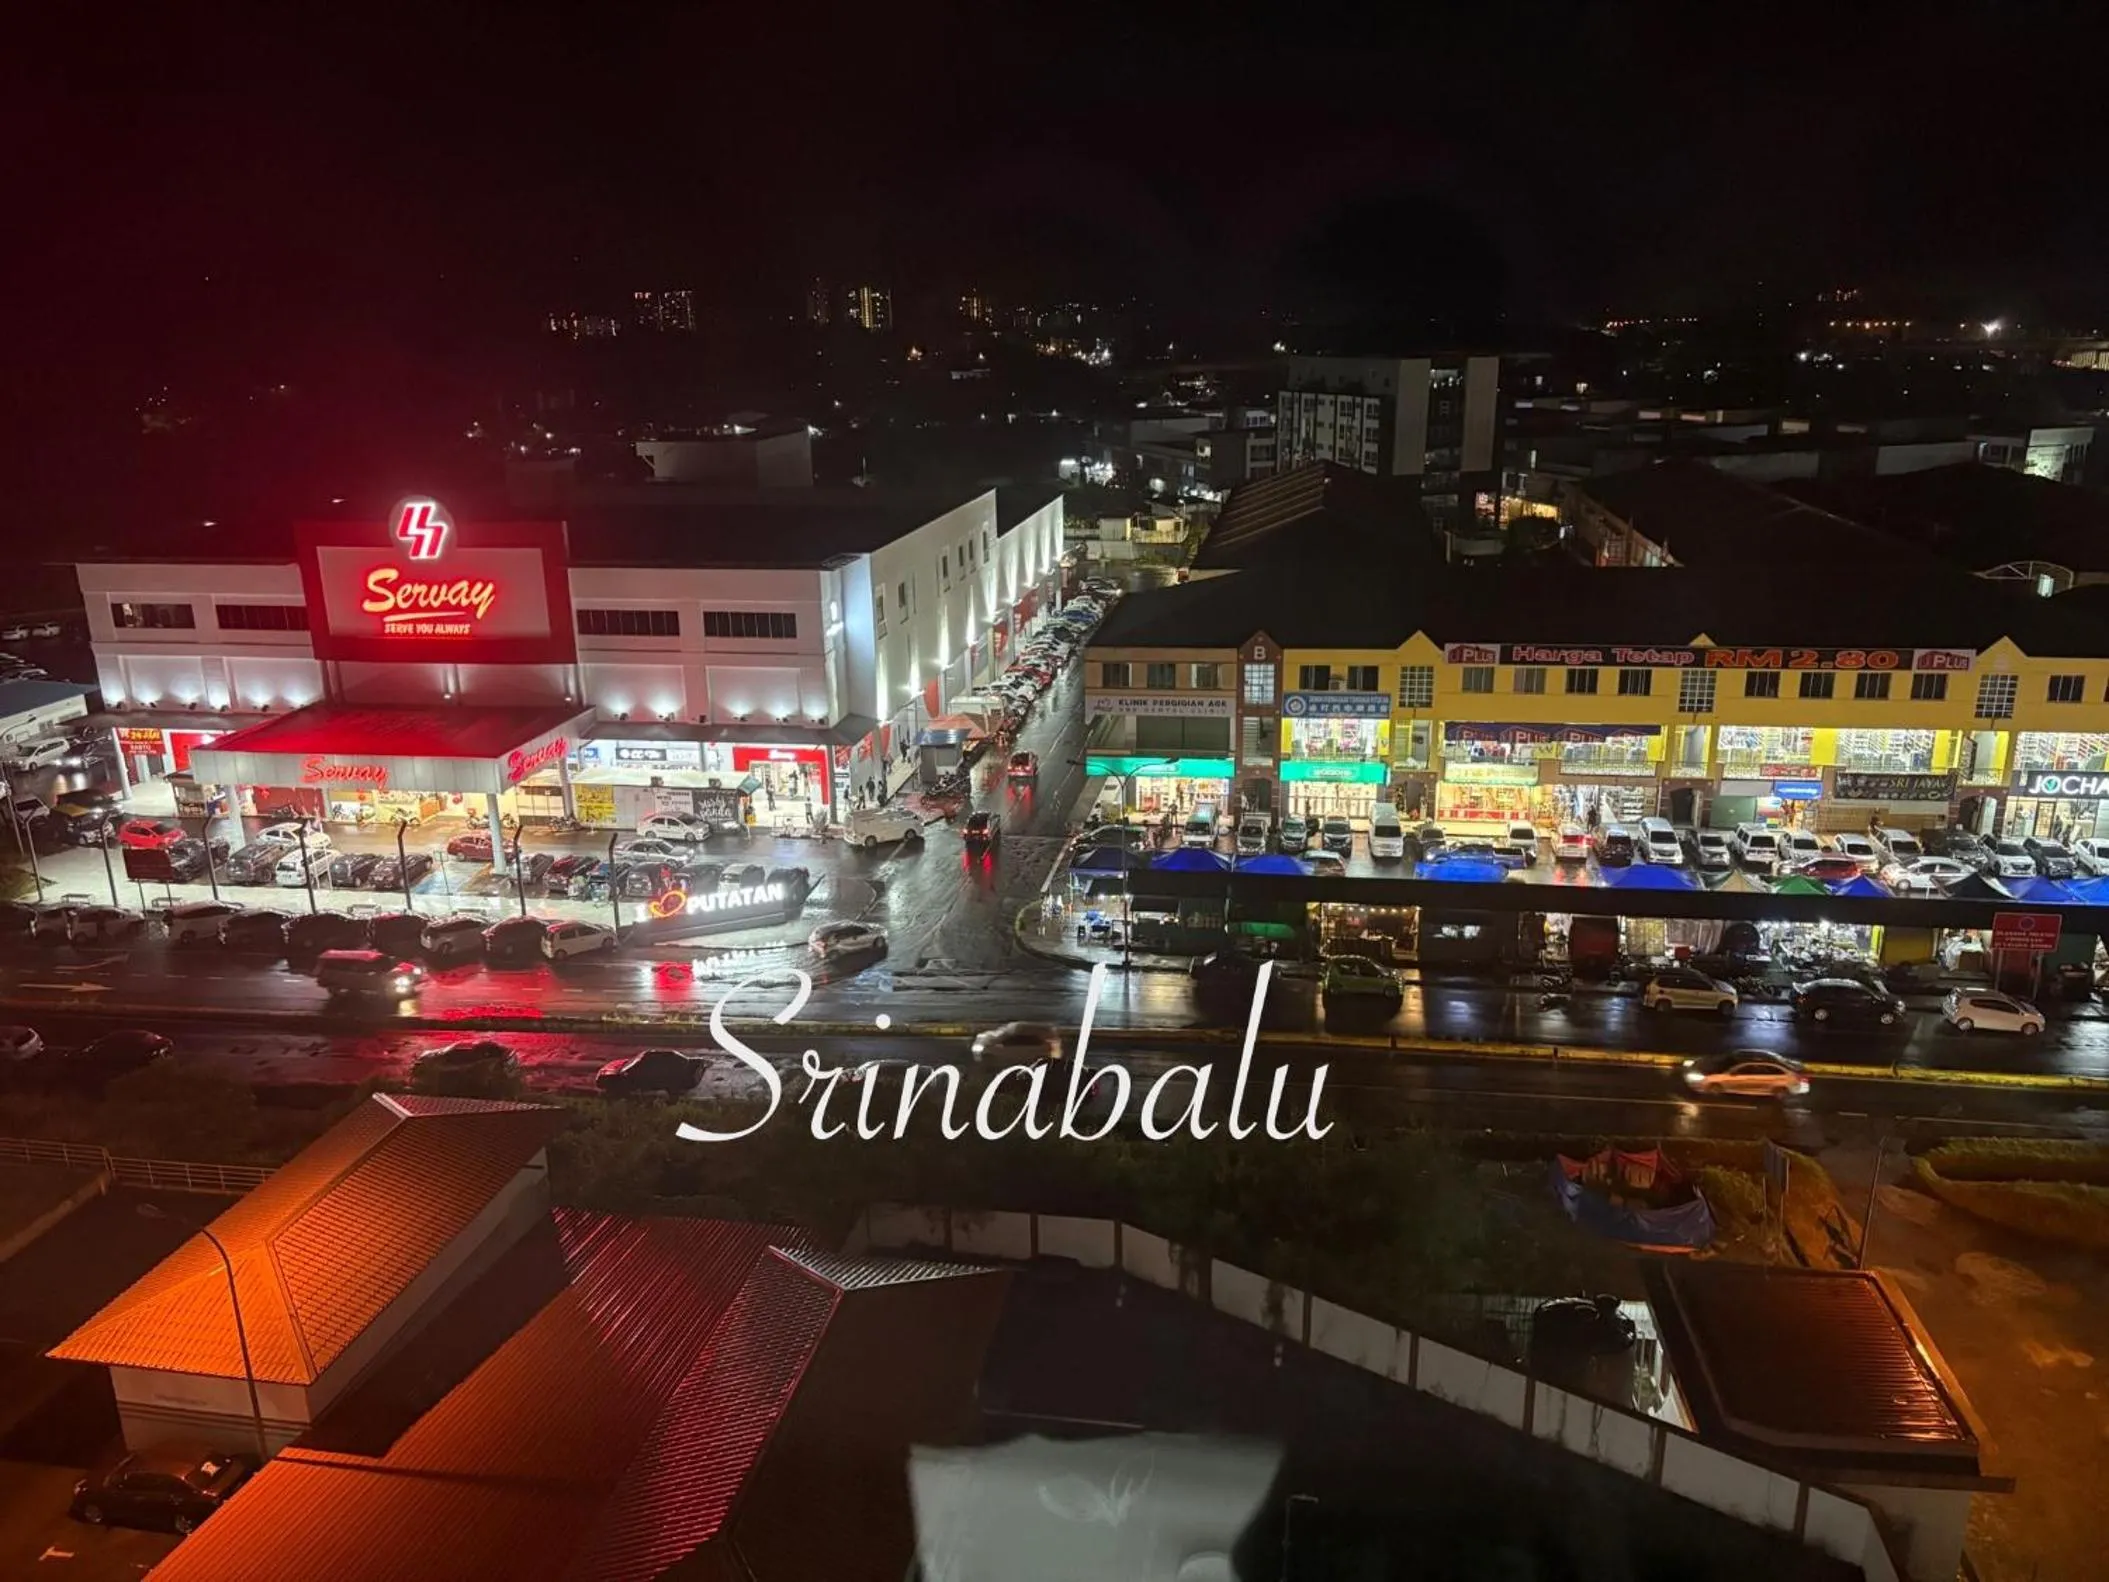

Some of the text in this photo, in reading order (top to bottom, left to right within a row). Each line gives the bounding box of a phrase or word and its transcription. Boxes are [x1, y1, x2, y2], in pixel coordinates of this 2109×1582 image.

[362, 567, 495, 619] Servay
[384, 623, 471, 635] SERVE YOU ALWAYS
[1512, 646, 1899, 669] Harga Tetap RM 2.80
[1152, 699, 1204, 707] PERGIGIAN
[302, 755, 389, 790] Servay
[507, 737, 567, 781] Servay
[686, 883, 783, 915] PUTATAN
